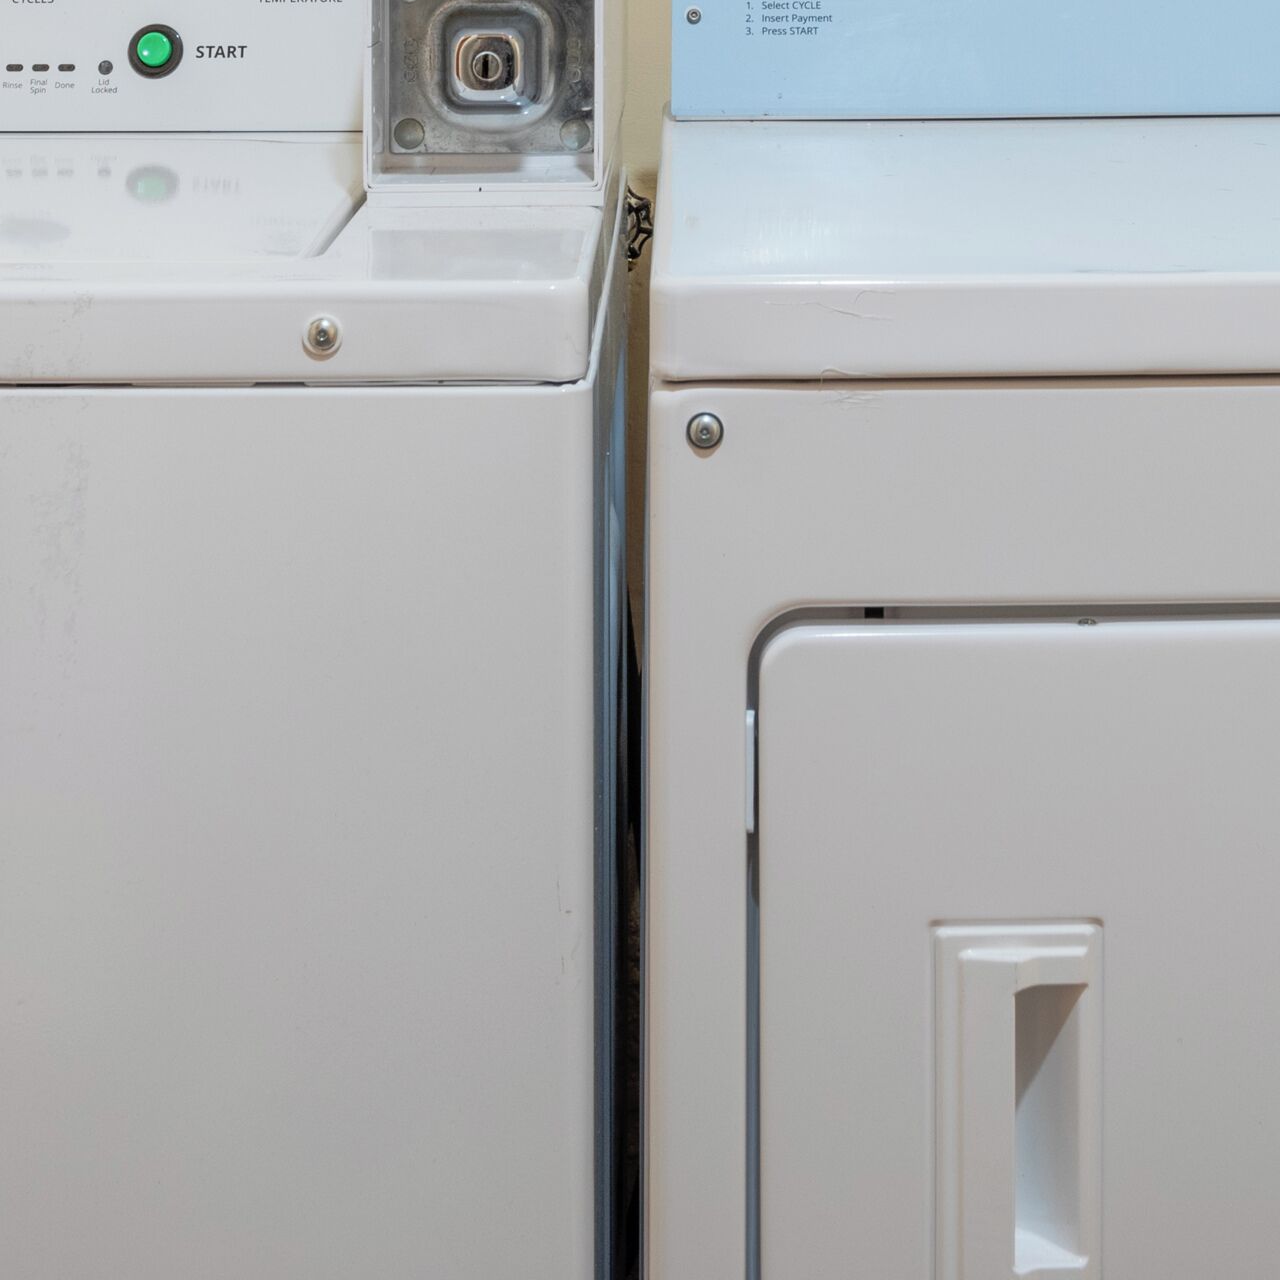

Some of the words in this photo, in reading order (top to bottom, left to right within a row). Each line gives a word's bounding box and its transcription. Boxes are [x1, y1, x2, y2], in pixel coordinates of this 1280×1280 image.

[747, 1, 754, 11] 1.
[762, 1, 790, 10] Select
[792, 1, 822, 10] CYCLE
[746, 14, 755, 23] 2.
[762, 14, 790, 23] Insert
[792, 14, 832, 24] Payment
[746, 27, 754, 36] 3.
[762, 27, 788, 36] Press
[790, 27, 819, 36] START
[196, 46, 247, 58] START
[99, 79, 110, 87] Lid
[30, 87, 47, 96] Spin
